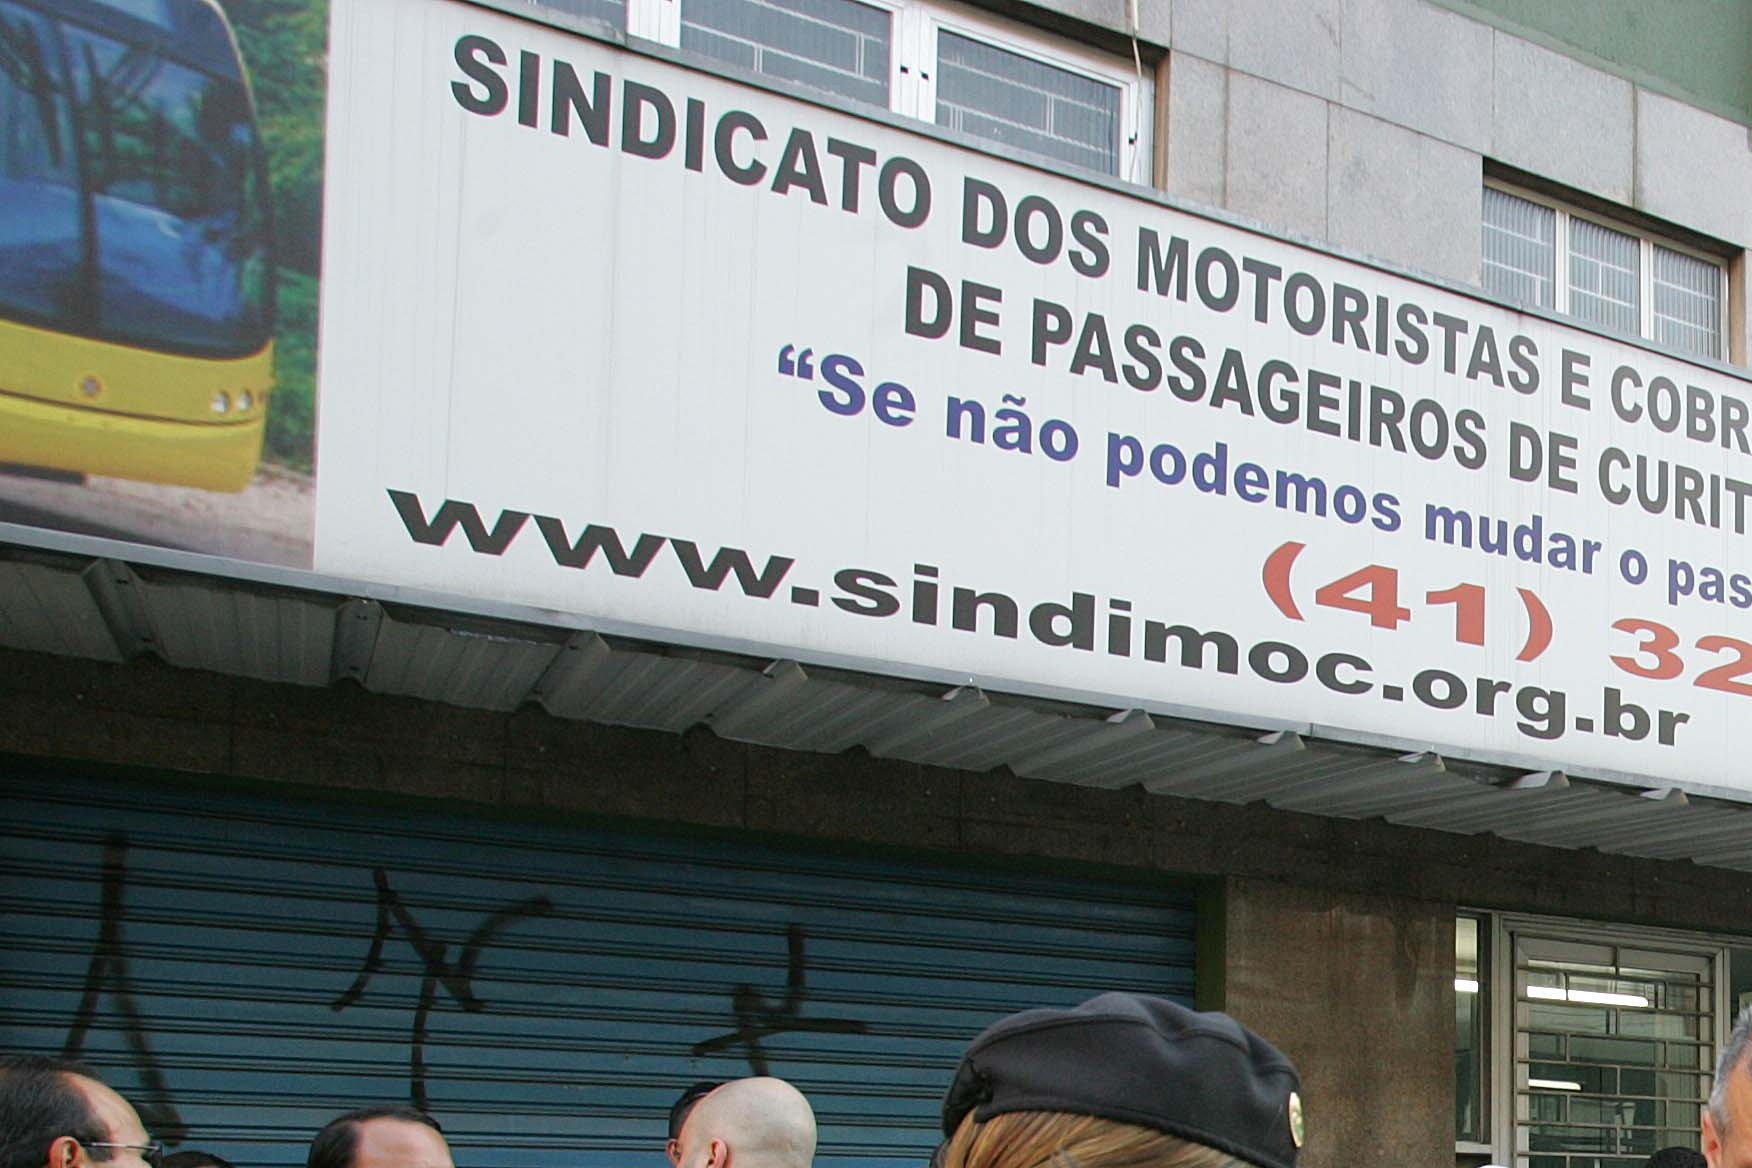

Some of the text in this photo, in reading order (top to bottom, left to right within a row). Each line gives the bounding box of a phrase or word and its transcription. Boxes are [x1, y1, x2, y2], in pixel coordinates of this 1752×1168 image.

[450, 33, 932, 230] SINDICATO
[961, 175, 1110, 279] DOS
[1138, 227, 1540, 395] MOTORISTAS
[1561, 347, 1591, 412] E
[905, 264, 1003, 356] DE
[1031, 296, 1487, 470] PASSAGEIROS
[1509, 419, 1578, 495] DE
[946, 392, 1078, 462] não
[1105, 430, 1401, 532] podemos
[1425, 502, 1603, 575] mudar
[1620, 549, 1648, 586] o
[387, 488, 1691, 747] www.sindimoc.org.br
[1262, 541, 1553, 662] (41)
